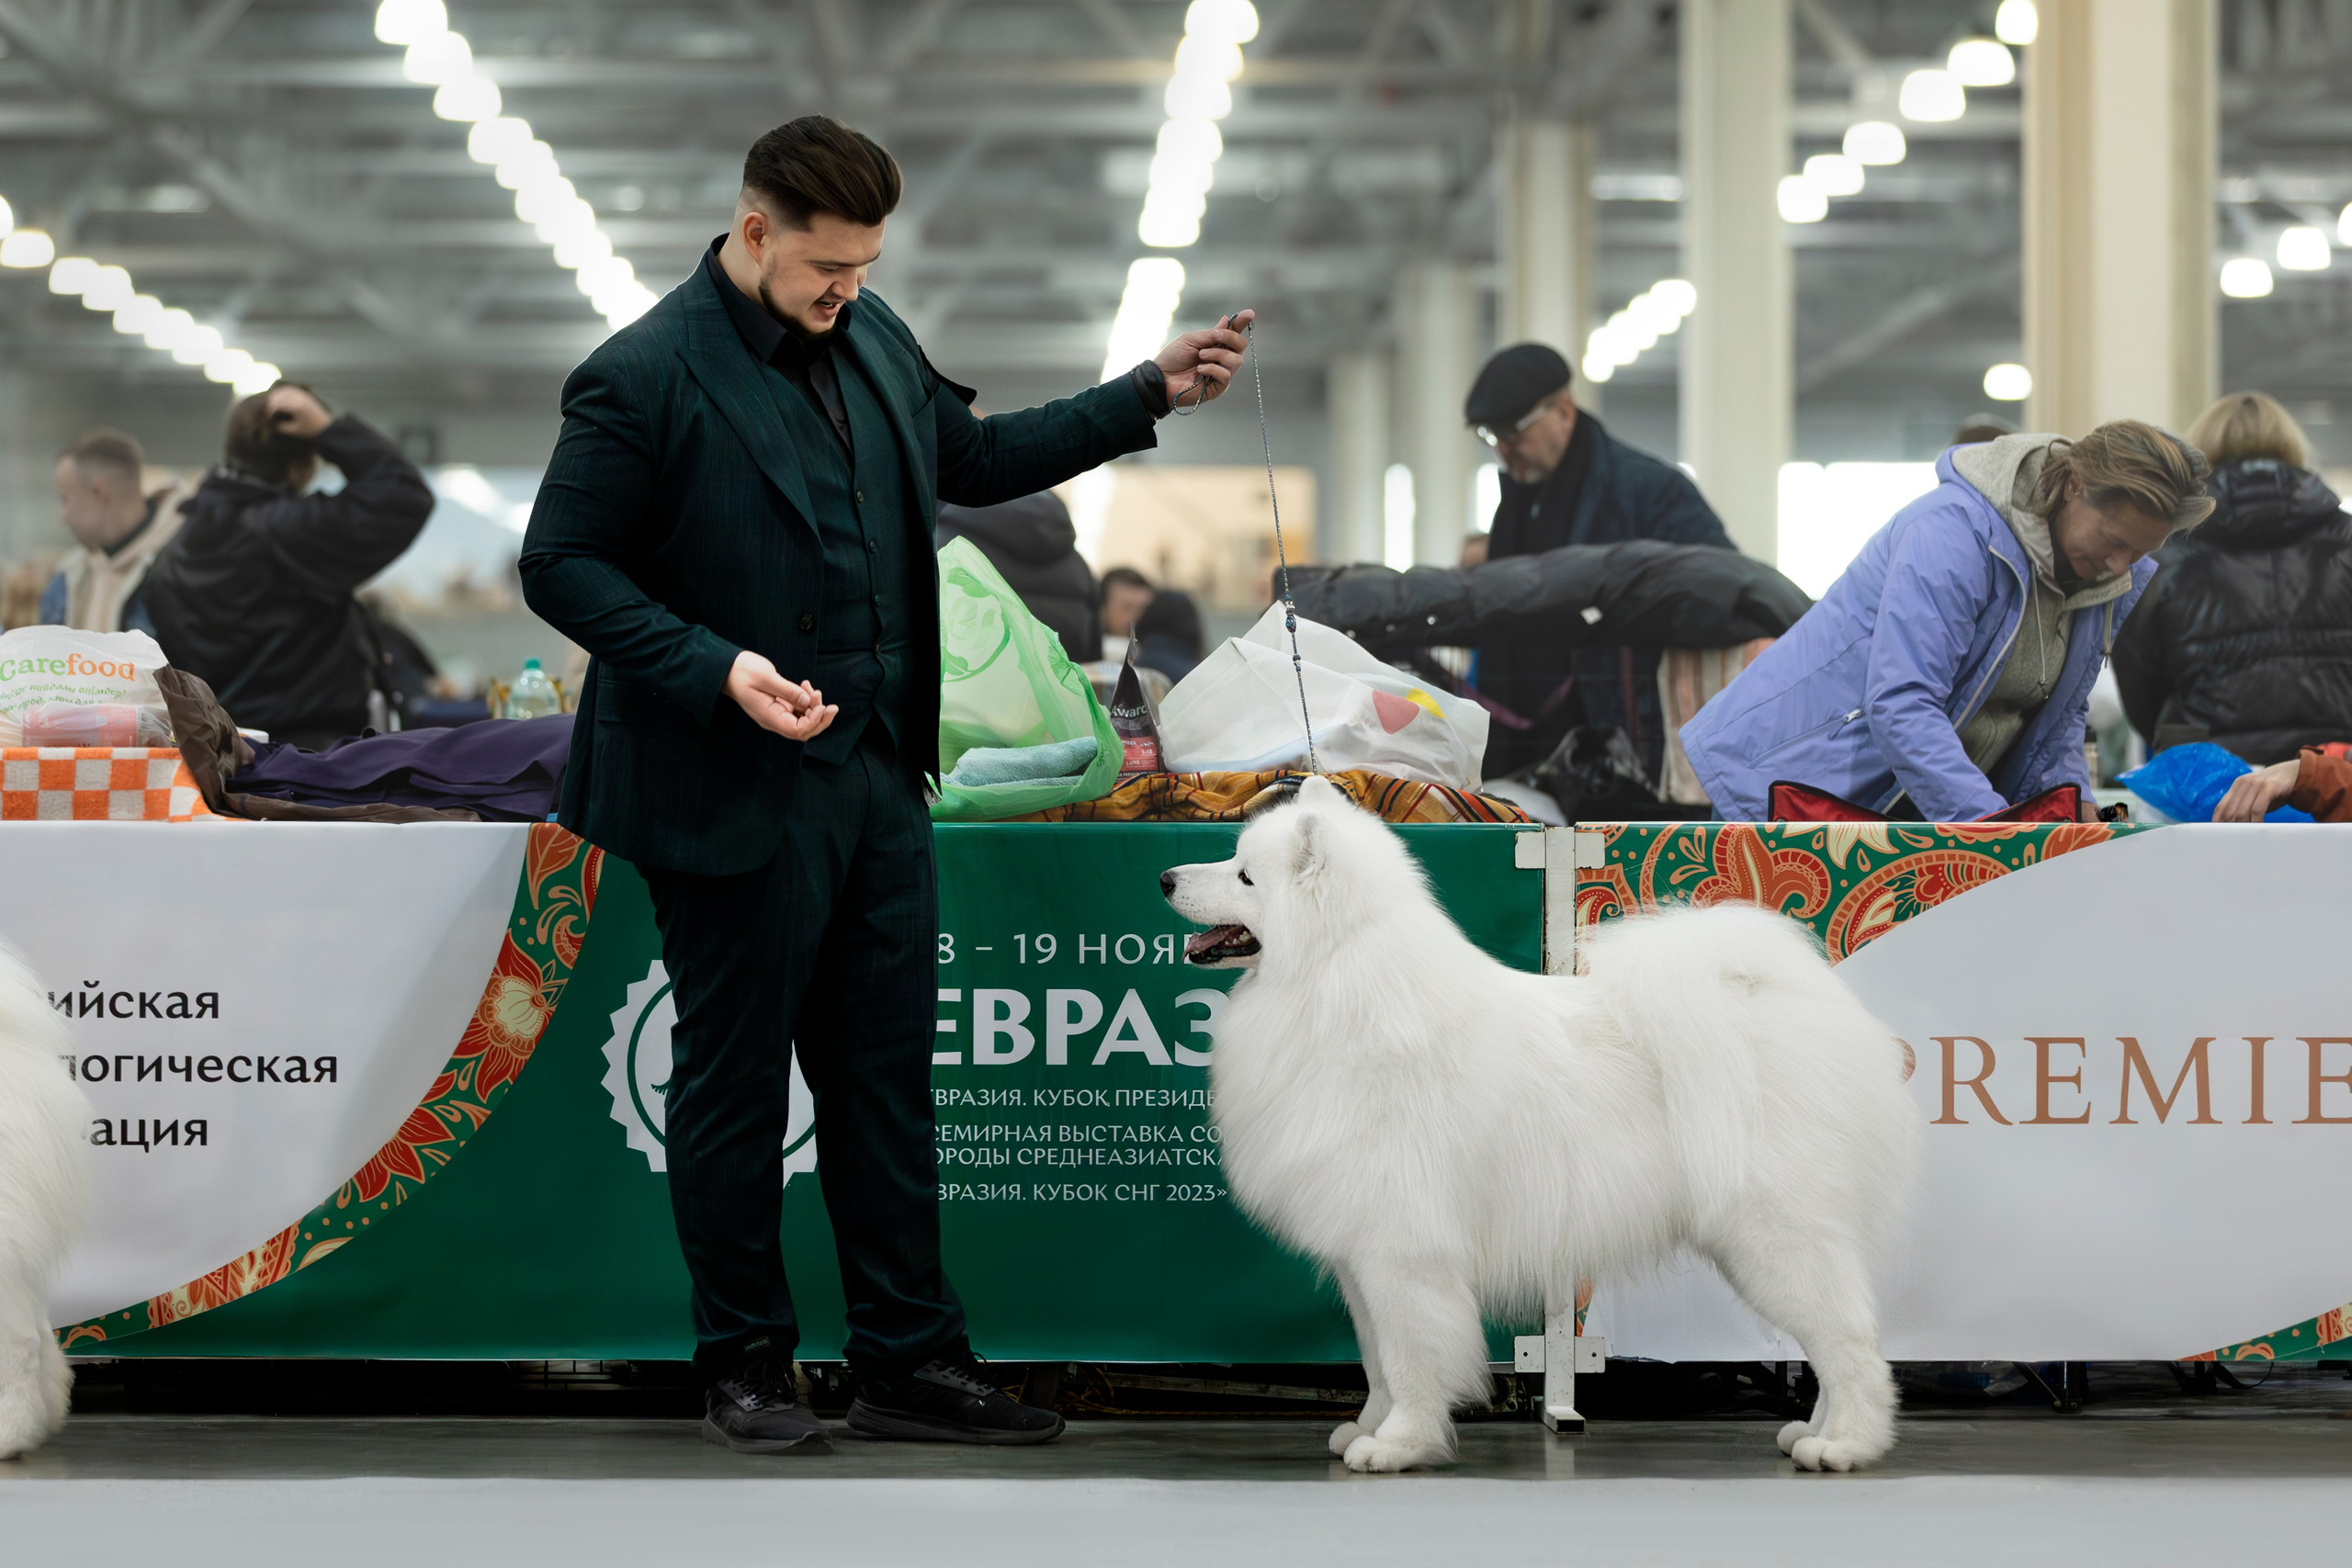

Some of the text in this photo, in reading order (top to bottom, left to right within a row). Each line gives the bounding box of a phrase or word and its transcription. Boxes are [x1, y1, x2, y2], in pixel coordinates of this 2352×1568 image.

[0, 653, 135, 682] Carefood
[1013, 933, 1057, 964] 19
[932, 988, 1228, 1066] ЕВРАЗ
[931, 1089, 1026, 1106] ВРАЗИЯ.
[1034, 1089, 1108, 1107] КУБОК
[1059, 1125, 1183, 1143] ВЫСТАВКА
[1034, 1184, 1108, 1201] КУБОК
[1114, 1184, 1160, 1201] СНГ
[1166, 1184, 1227, 1201] 2023»
